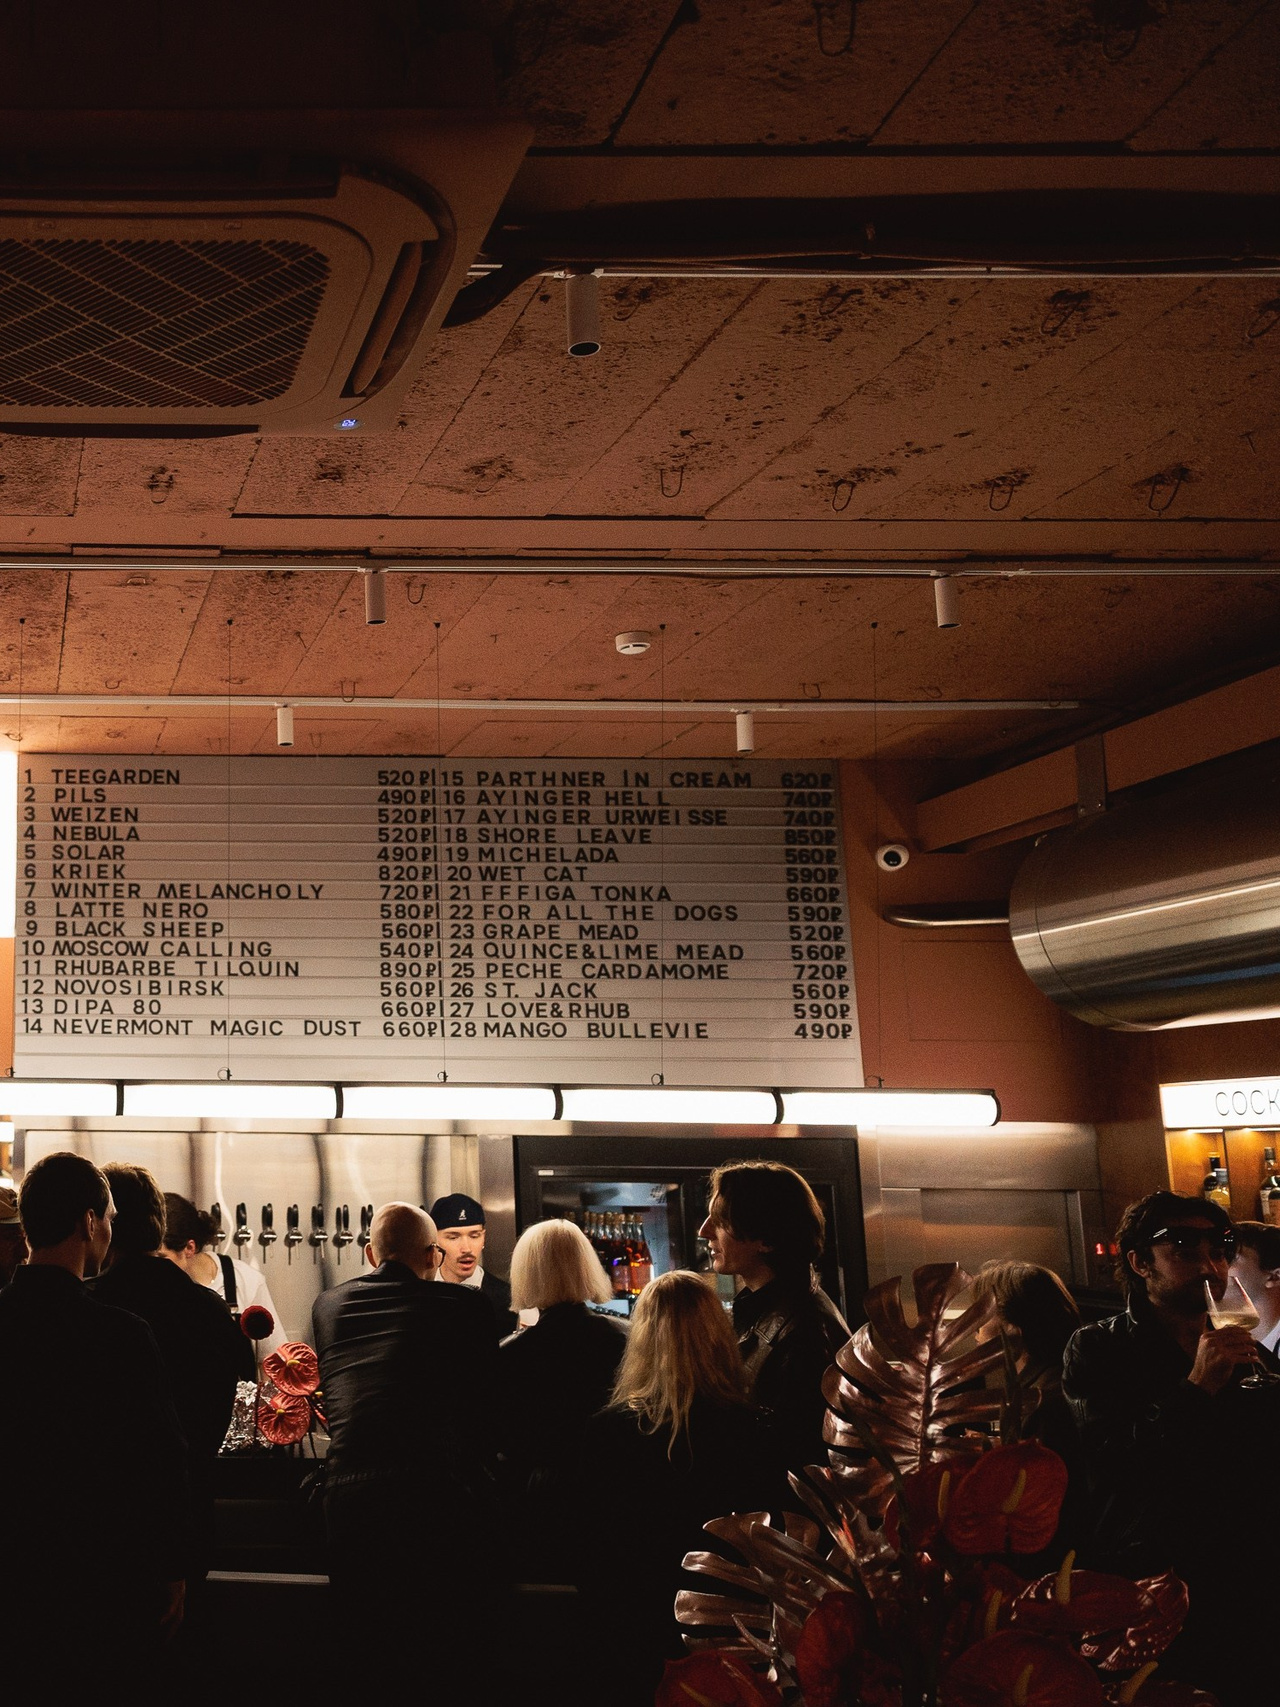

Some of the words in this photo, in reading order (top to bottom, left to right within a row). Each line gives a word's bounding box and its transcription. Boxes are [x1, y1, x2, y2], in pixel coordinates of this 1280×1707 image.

[24, 768, 32, 784] 1
[52, 769, 180, 785] TEEGARDEN
[441, 771, 464, 787] 15
[477, 771, 606, 788] PARTHNER
[624, 770, 649, 788] IN
[670, 771, 751, 788] CREAM
[24, 787, 35, 803] 2
[55, 788, 106, 804] PILS
[444, 790, 465, 806] 16
[477, 791, 591, 806] AYINGER
[606, 791, 670, 806] HELL
[24, 806, 35, 822] 3
[51, 807, 139, 823] WEIZEN
[444, 809, 465, 825] 17
[477, 810, 591, 825] AYINGER
[24, 825, 36, 840] 4
[54, 826, 140, 841] NEBULA
[445, 828, 468, 844] 18
[478, 828, 556, 844] SHORE
[577, 828, 652, 844] LEAVE
[24, 844, 36, 859] 5
[52, 845, 125, 860] SOLAR
[446, 847, 469, 863] 19
[478, 848, 618, 863] MICHELADA
[24, 863, 36, 878] 6
[53, 864, 125, 879] KRIEK
[448, 866, 472, 882] 20
[479, 866, 527, 882] WET
[544, 867, 588, 882] CAT
[24, 882, 35, 898] 7
[52, 883, 141, 899] WINTER
[158, 884, 324, 900] MELANCHOLY
[448, 886, 471, 901] 21
[591, 886, 671, 901] TONKA
[24, 901, 36, 917] 8
[56, 902, 125, 918] LATTE
[143, 902, 209, 918] NERO
[449, 905, 474, 920] 22
[483, 905, 530, 920] FOR
[548, 905, 593, 921] ALL
[606, 905, 653, 921] THE
[676, 905, 738, 921] DOGS
[25, 920, 37, 936] 9
[55, 922, 125, 937] BLACK
[143, 922, 224, 937] SHEEP
[450, 924, 474, 939] 23
[483, 924, 560, 939] GRAPE
[579, 924, 639, 940] MEAD
[23, 940, 45, 956] 10
[52, 941, 149, 957] MOSCOW
[160, 941, 271, 957] CALLING
[450, 943, 474, 960] 24
[677, 943, 743, 960] MEAD
[23, 960, 41, 976] 11
[55, 961, 175, 977] RHUBARBE
[195, 961, 299, 977] TILQUIN
[451, 963, 475, 979] 25
[487, 963, 562, 979] PECHE
[582, 964, 729, 979] CARDAMOME
[23, 979, 44, 995] 12
[55, 980, 224, 996] NOVOSIBIRSK
[450, 982, 473, 998] 26
[485, 982, 519, 998] ST.
[535, 983, 597, 998] JACK
[22, 998, 44, 1014] 13
[54, 1000, 114, 1016] DIPA
[133, 1000, 161, 1016] 80
[450, 1002, 473, 1018] 27
[23, 1018, 43, 1035] 14
[54, 1019, 193, 1036] NEVERMONT
[211, 1020, 283, 1037] MAGIC
[304, 1020, 361, 1037] DUST
[451, 1022, 476, 1038] 28
[484, 1022, 567, 1038] MANGO
[588, 1022, 709, 1038] BULLEVIE
